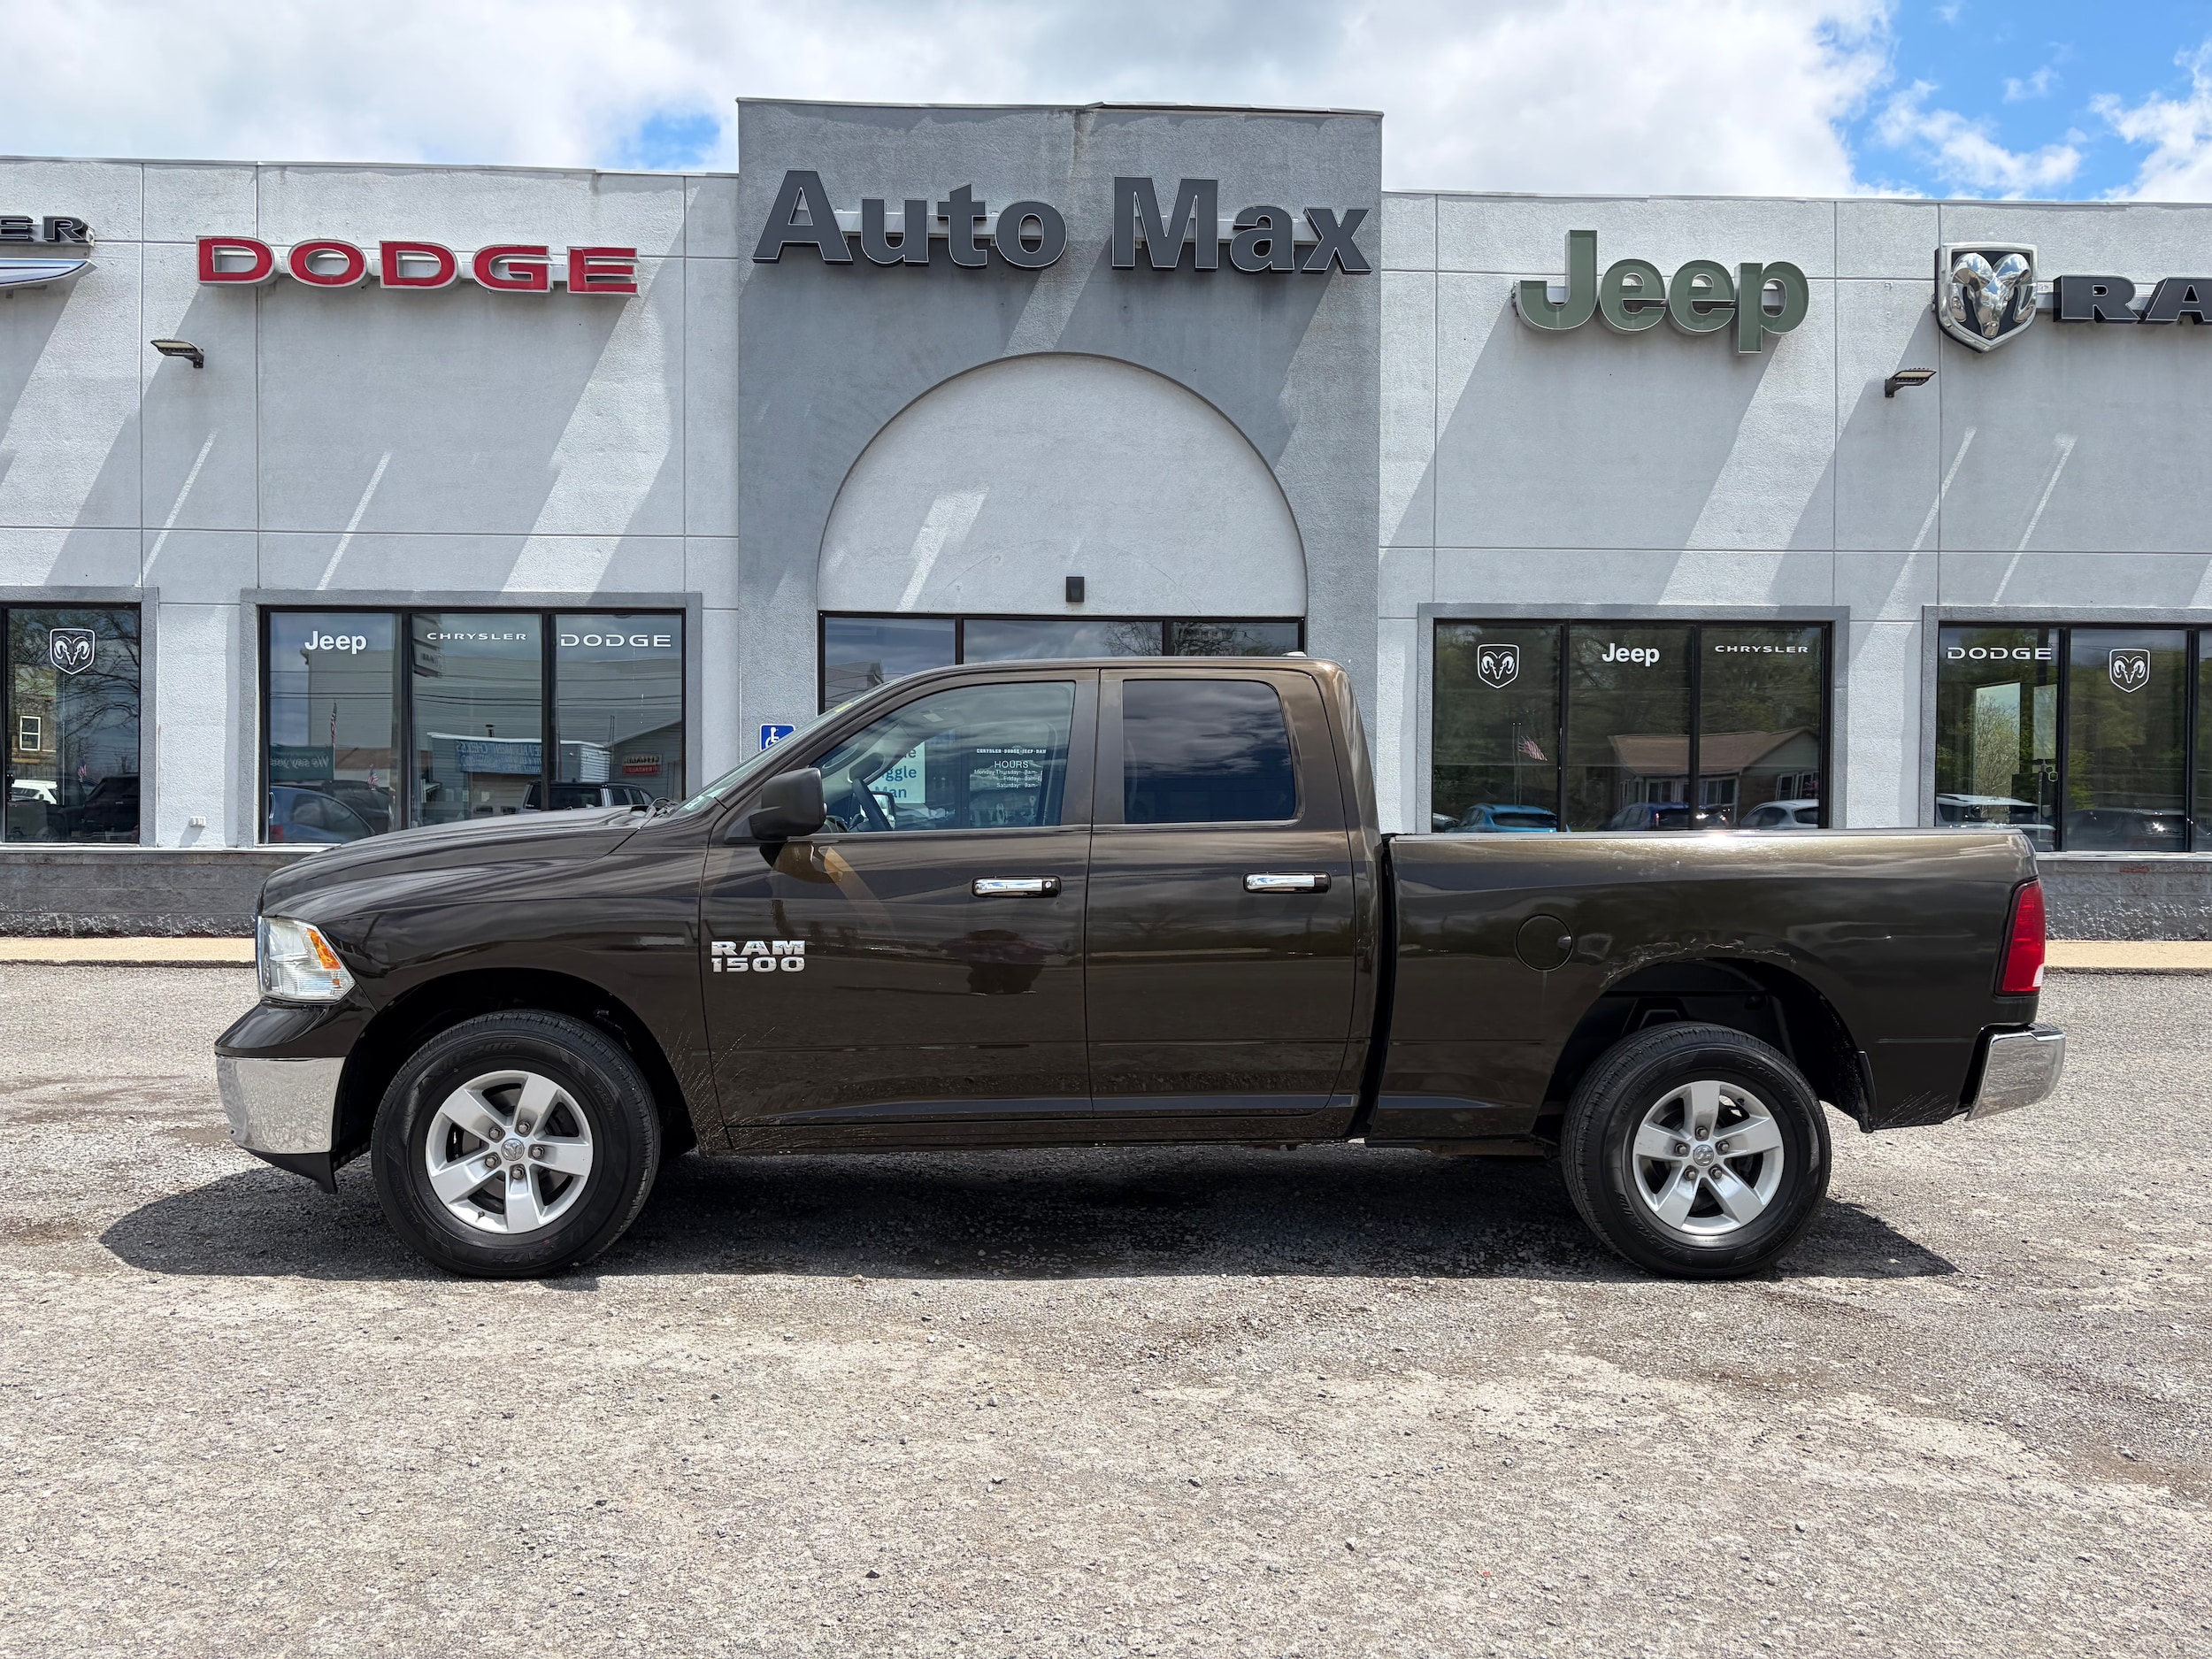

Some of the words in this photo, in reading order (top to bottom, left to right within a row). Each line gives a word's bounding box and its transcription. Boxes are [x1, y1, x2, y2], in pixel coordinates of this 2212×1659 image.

[752, 170, 1068, 270] Auto
[1111, 176, 1372, 274] Max
[196, 235, 641, 295] DODGE
[1514, 230, 1809, 353] Jeep
[2054, 275, 2212, 325] RA
[304, 630, 367, 655] Jeep
[560, 634, 672, 648] DODGE
[1602, 643, 1659, 667] Jeep
[1947, 647, 2052, 660] DODGE
[994, 760, 1029, 769] HOURS
[710, 940, 806, 956] RAM
[710, 956, 805, 972] 1500
